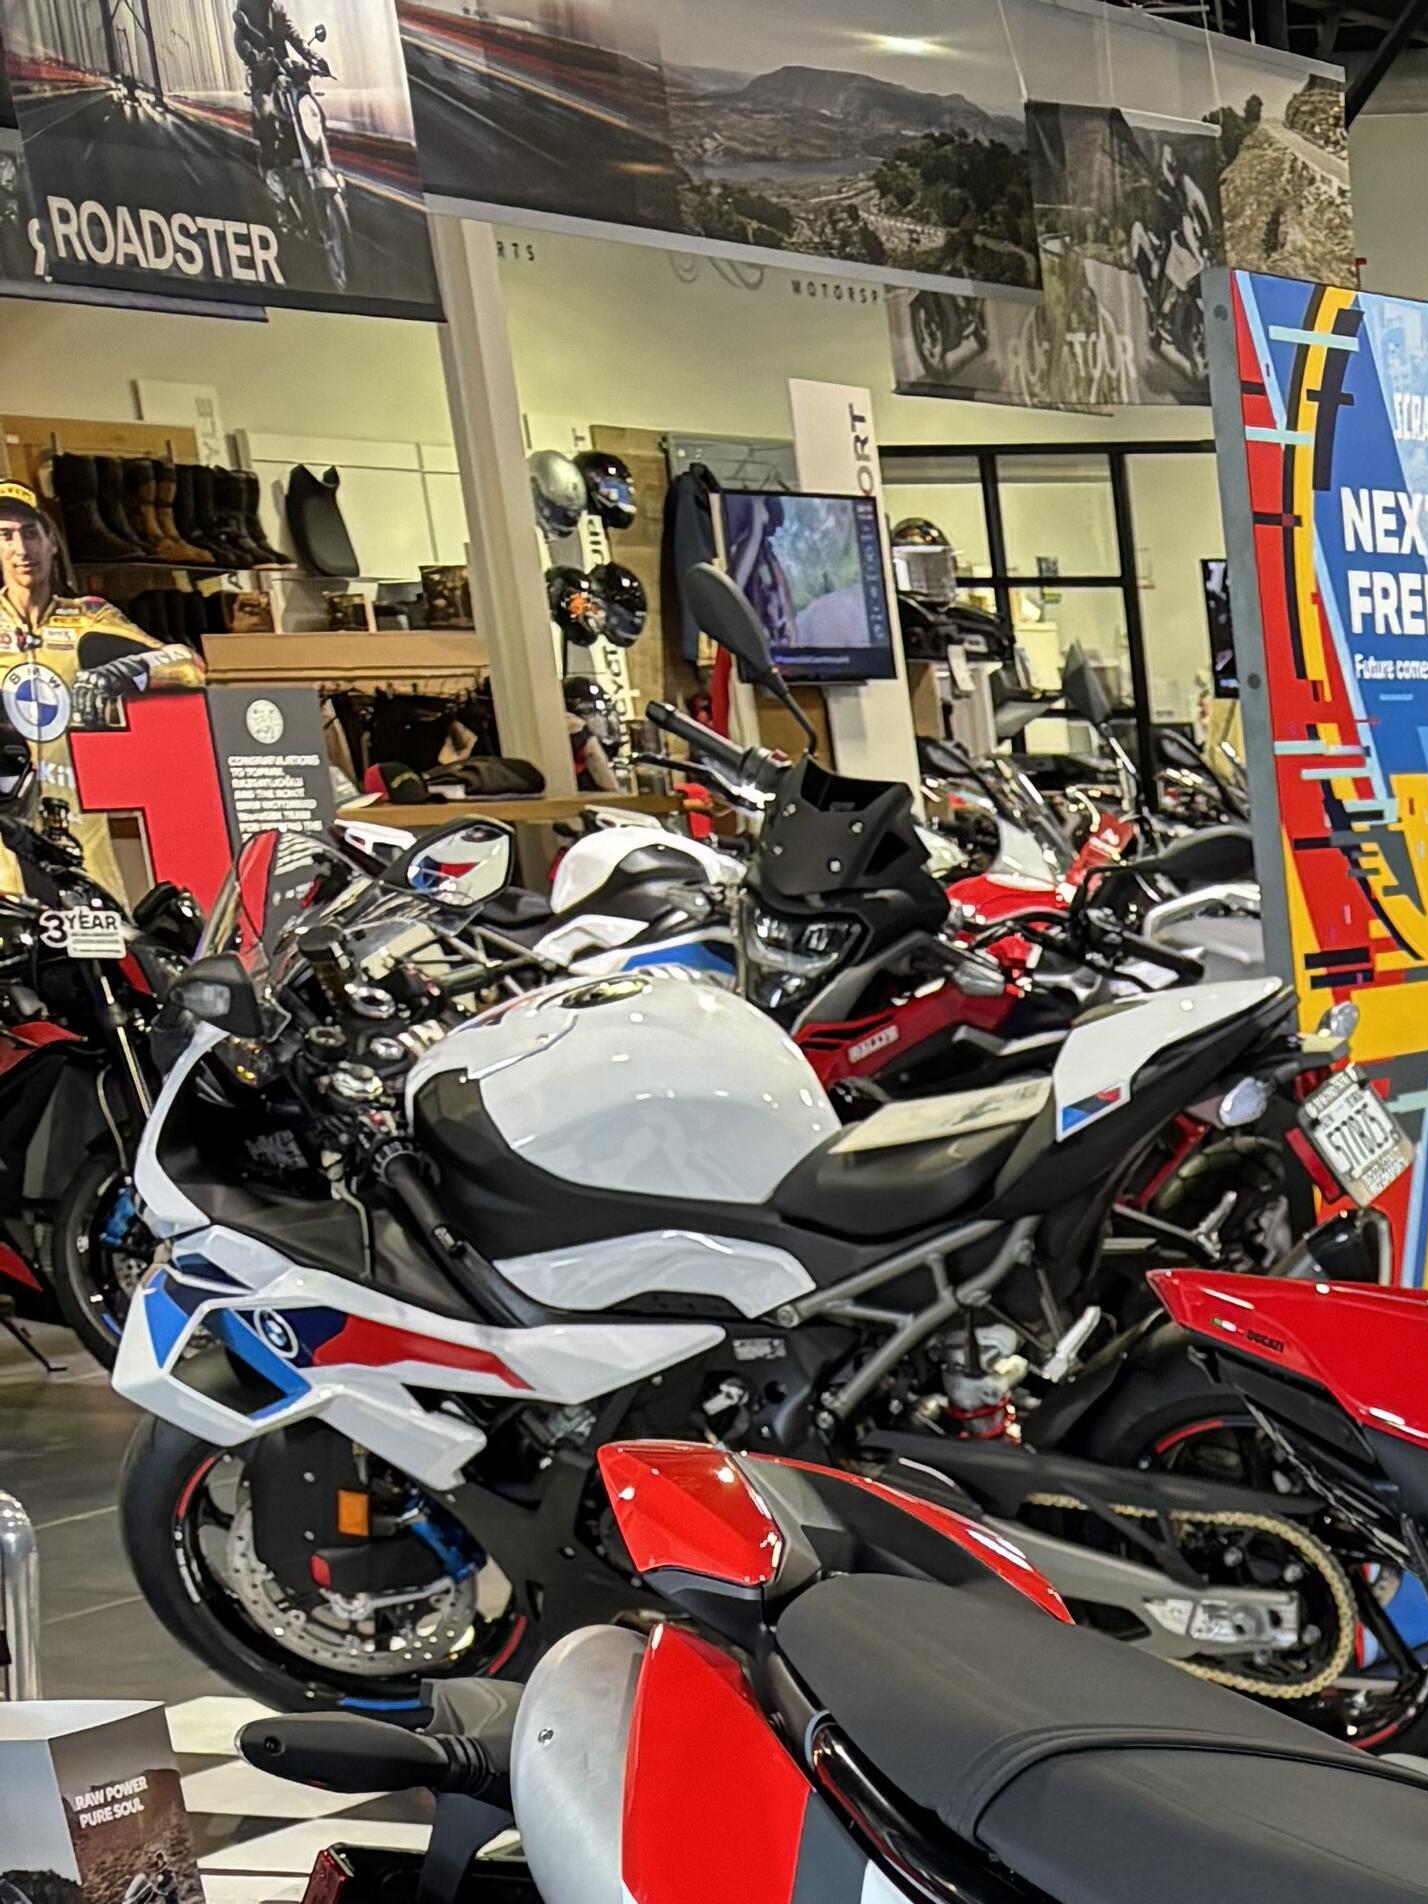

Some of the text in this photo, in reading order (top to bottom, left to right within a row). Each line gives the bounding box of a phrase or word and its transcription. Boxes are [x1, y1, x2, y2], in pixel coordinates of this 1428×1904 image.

[47, 195, 286, 284] ROADSTER
[1355, 652, 1394, 681] Future
[41, 915, 67, 944] 3
[66, 911, 118, 931] YEAR
[74, 1775, 149, 1812] RAW POWER
[79, 1797, 145, 1829] PURE SOUL
